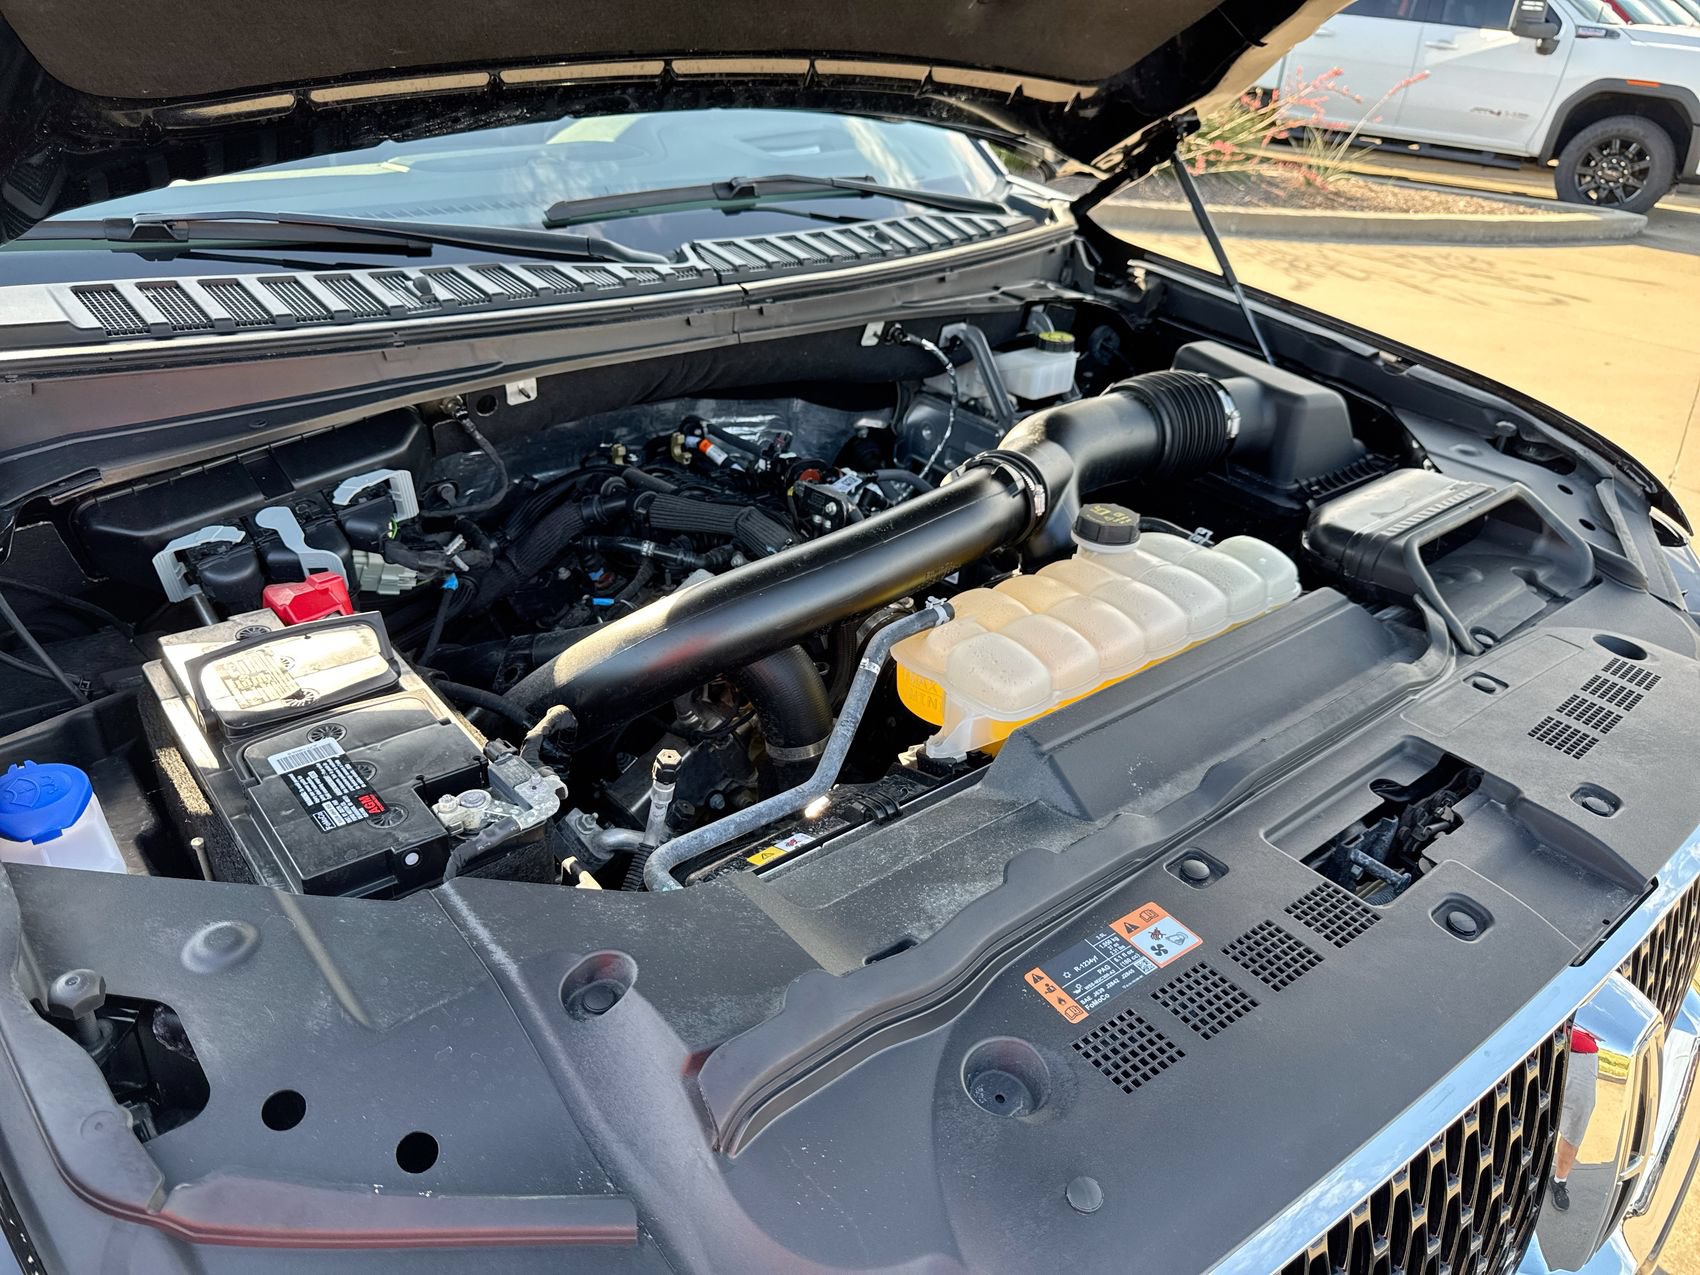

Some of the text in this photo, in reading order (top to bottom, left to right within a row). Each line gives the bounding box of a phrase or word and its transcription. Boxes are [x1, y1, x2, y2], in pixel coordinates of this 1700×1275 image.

[357, 795, 381, 815] AGM
[1073, 955, 1099, 973] R-1234yf
[1096, 964, 1111, 975] PAG
[1084, 993, 1110, 1011] FoMoCo
